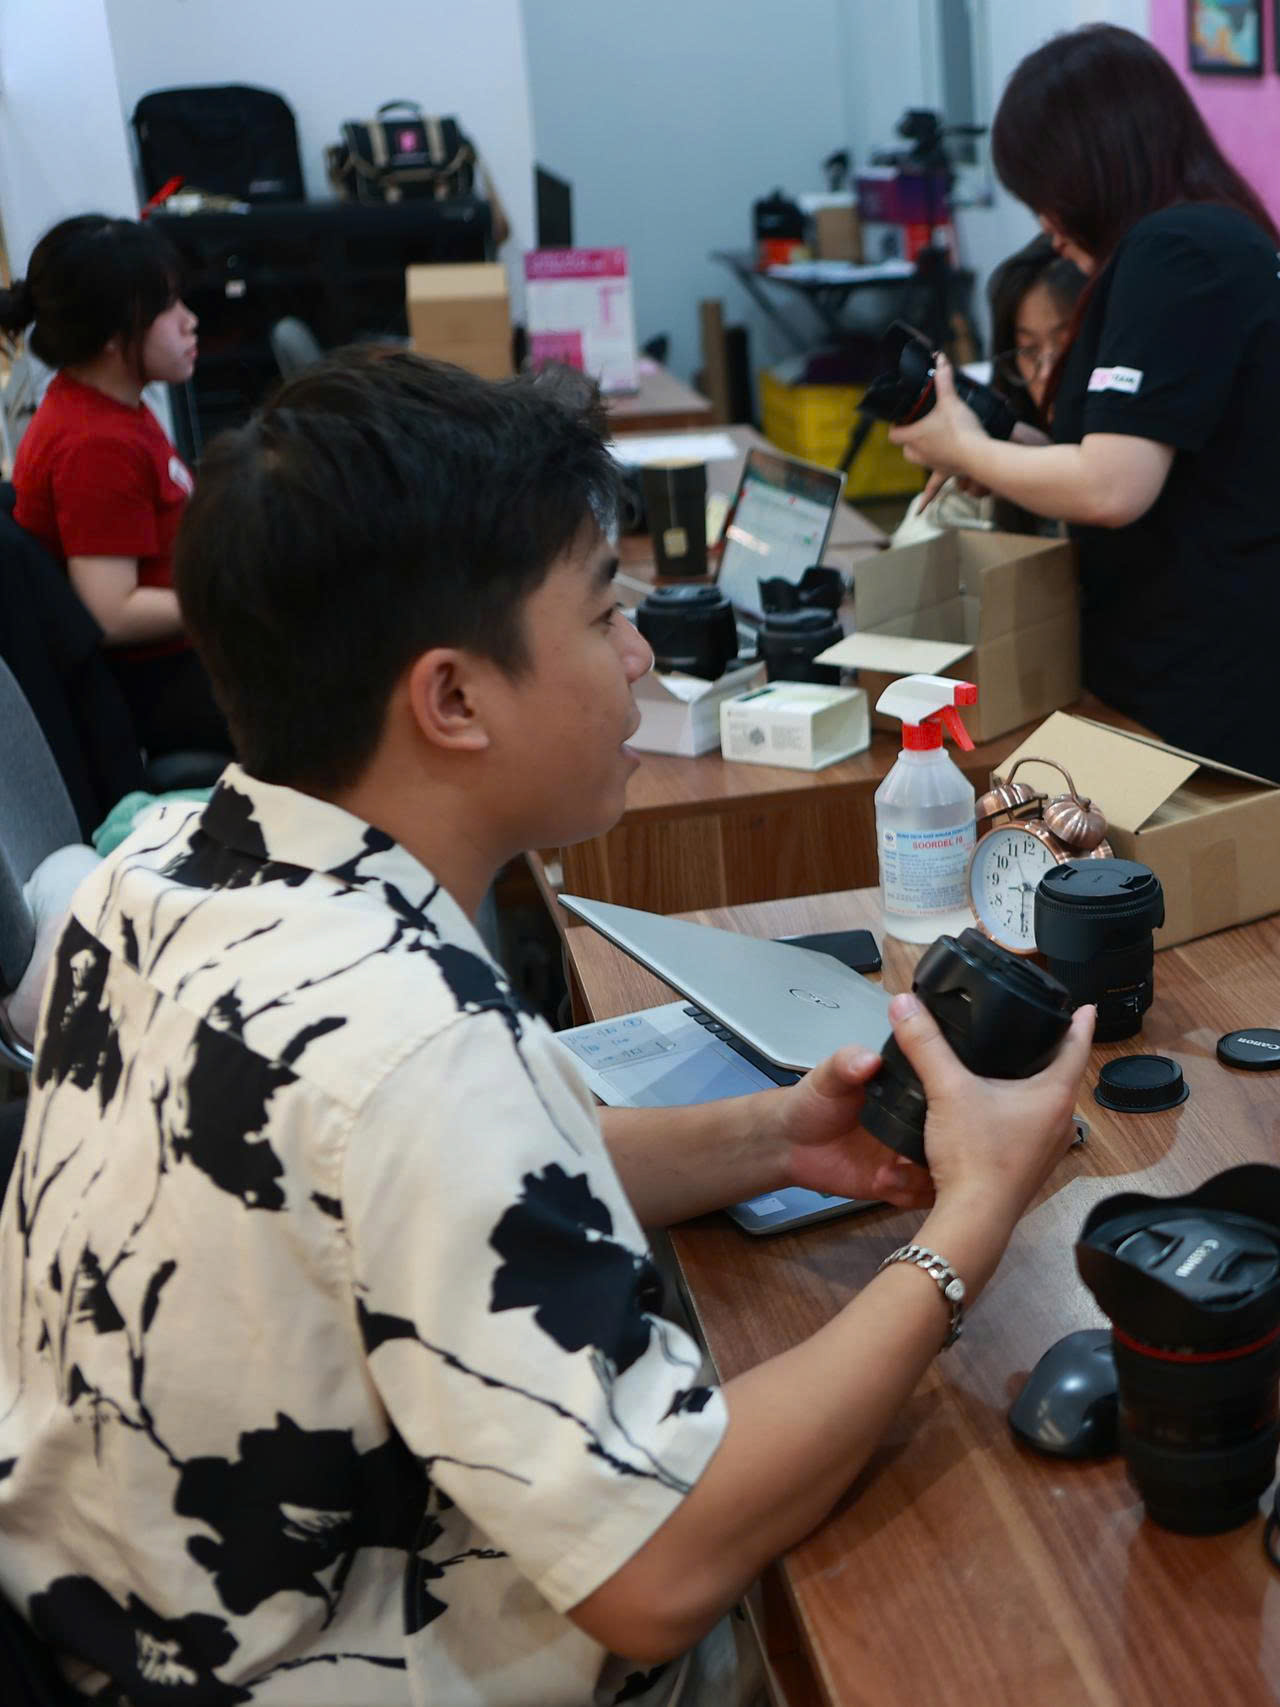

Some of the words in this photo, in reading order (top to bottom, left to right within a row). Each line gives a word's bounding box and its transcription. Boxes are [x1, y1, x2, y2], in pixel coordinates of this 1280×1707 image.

[1008, 843, 1017, 857] 11
[1023, 840, 1035, 856] 12
[997, 855, 1008, 870] 10
[1042, 850, 1046, 864] 1
[992, 872, 999, 886] 9
[995, 895, 1002, 907] 8
[1007, 910, 1013, 924] 7
[1238, 1038, 1280, 1050] Canon
[1175, 1239, 1219, 1277] Canon
